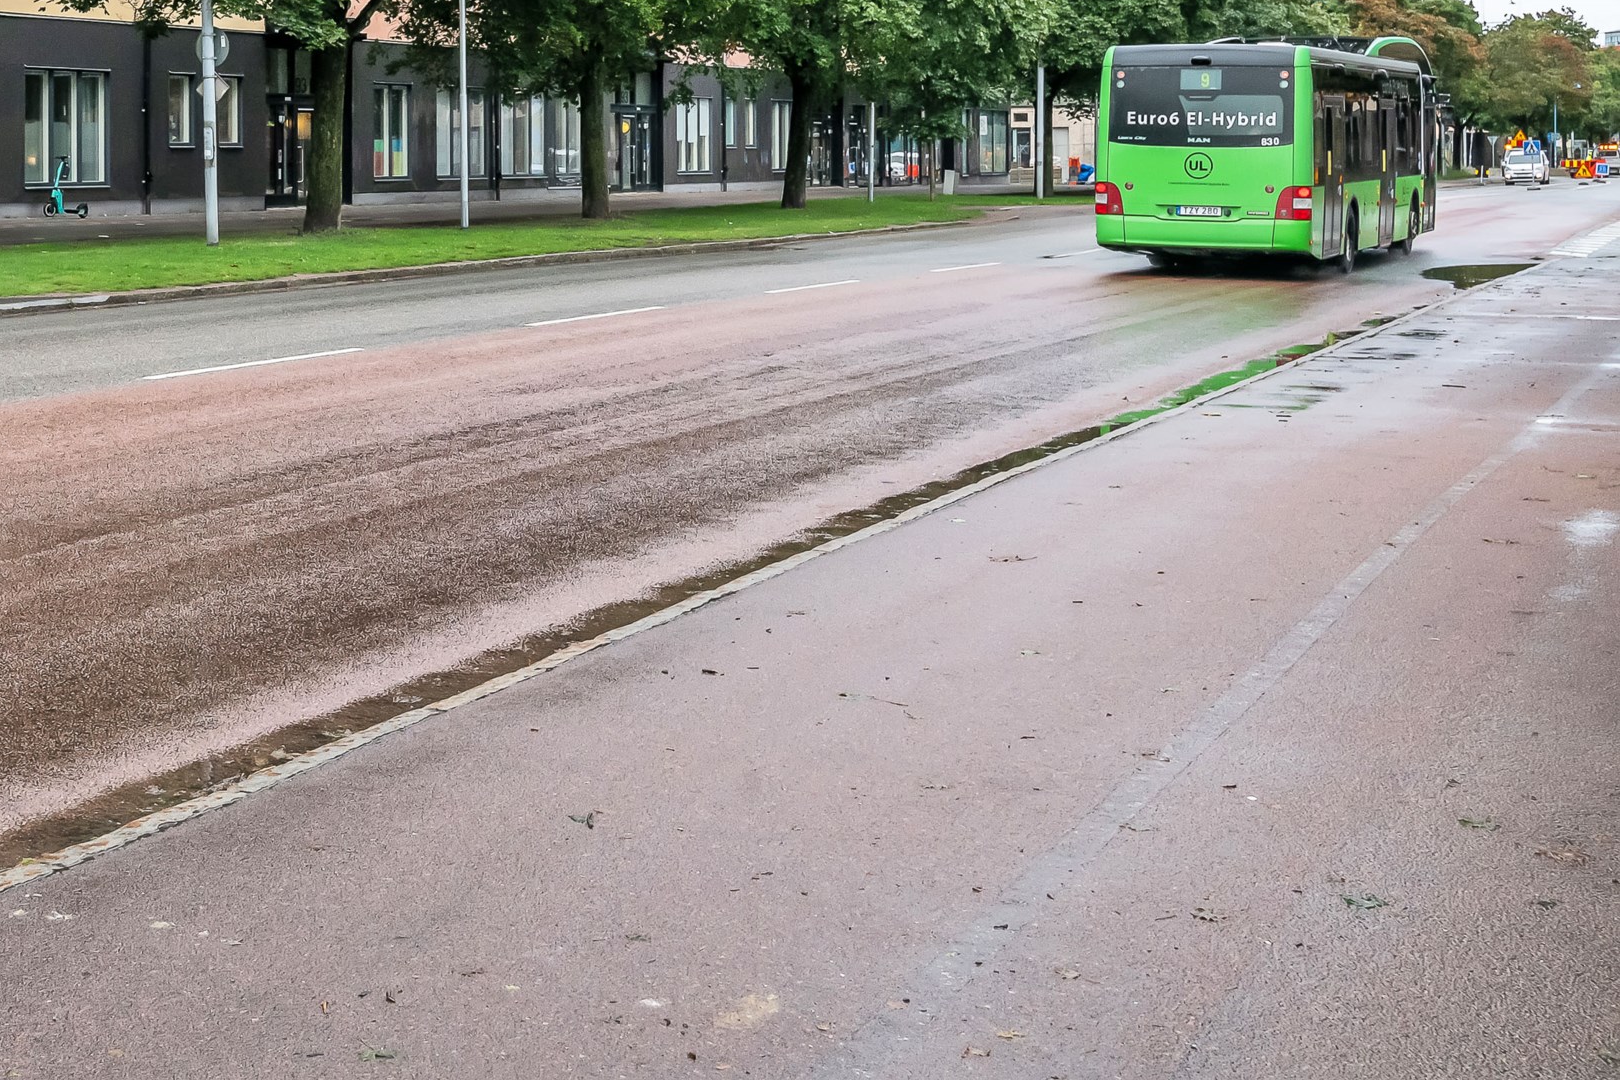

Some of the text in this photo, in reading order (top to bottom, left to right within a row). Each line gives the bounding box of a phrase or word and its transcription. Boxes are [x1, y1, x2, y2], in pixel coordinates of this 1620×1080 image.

[1200, 72, 1210, 88] 9
[1127, 111, 1277, 129] Euro6 El-Hybrid
[1261, 137, 1280, 146] 830
[1189, 161, 1208, 171] UL
[1183, 206, 1218, 215] TZY 280
